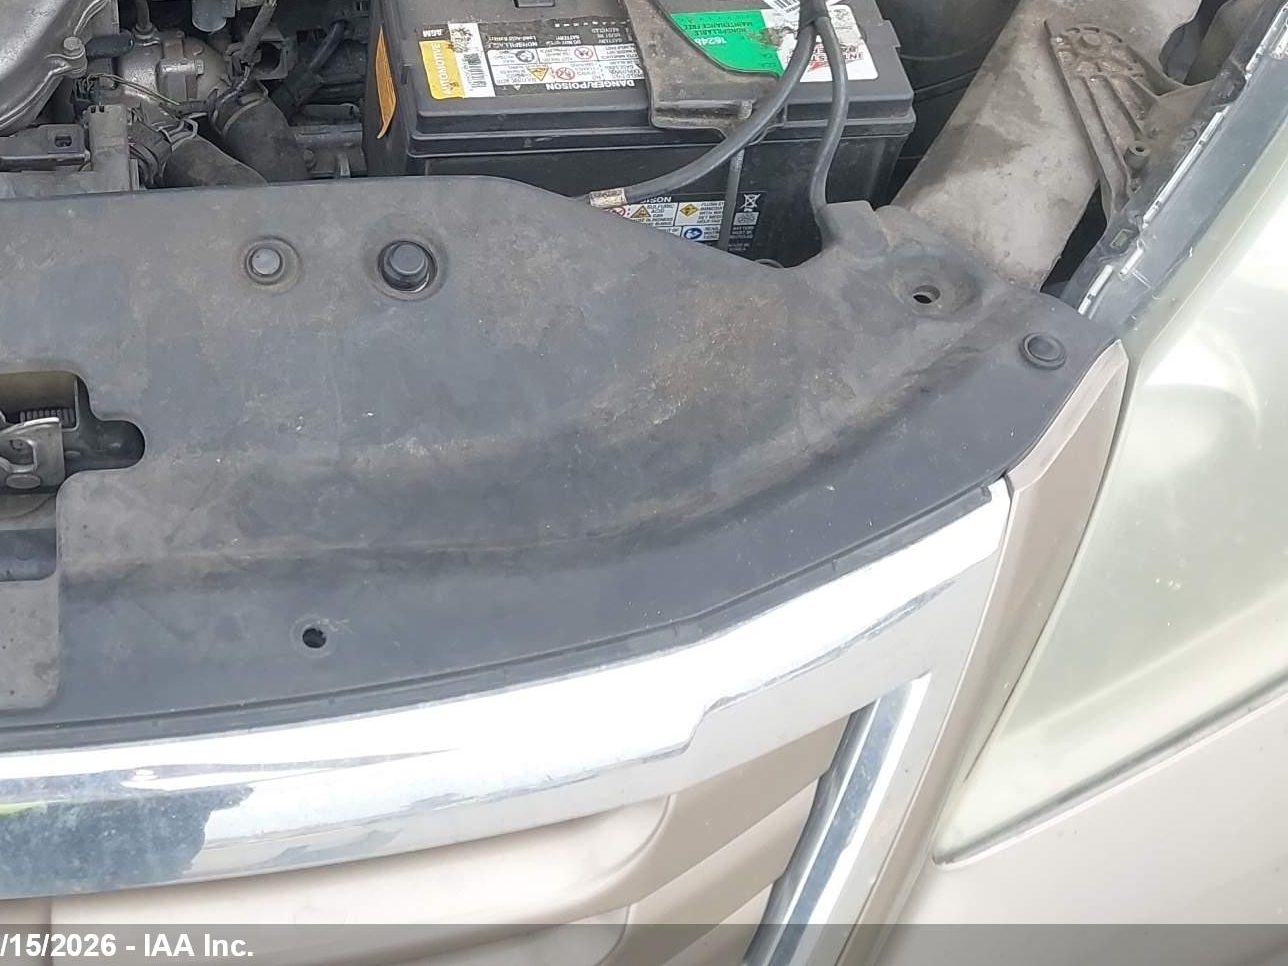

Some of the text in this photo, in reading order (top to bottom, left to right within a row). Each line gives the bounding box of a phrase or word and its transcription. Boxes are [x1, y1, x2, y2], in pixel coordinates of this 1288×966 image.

[702, 22, 753, 30] MAINTENANCE
[432, 42, 451, 94] AUTOMOTIVE
[545, 79, 636, 91] DANGER/POISON
